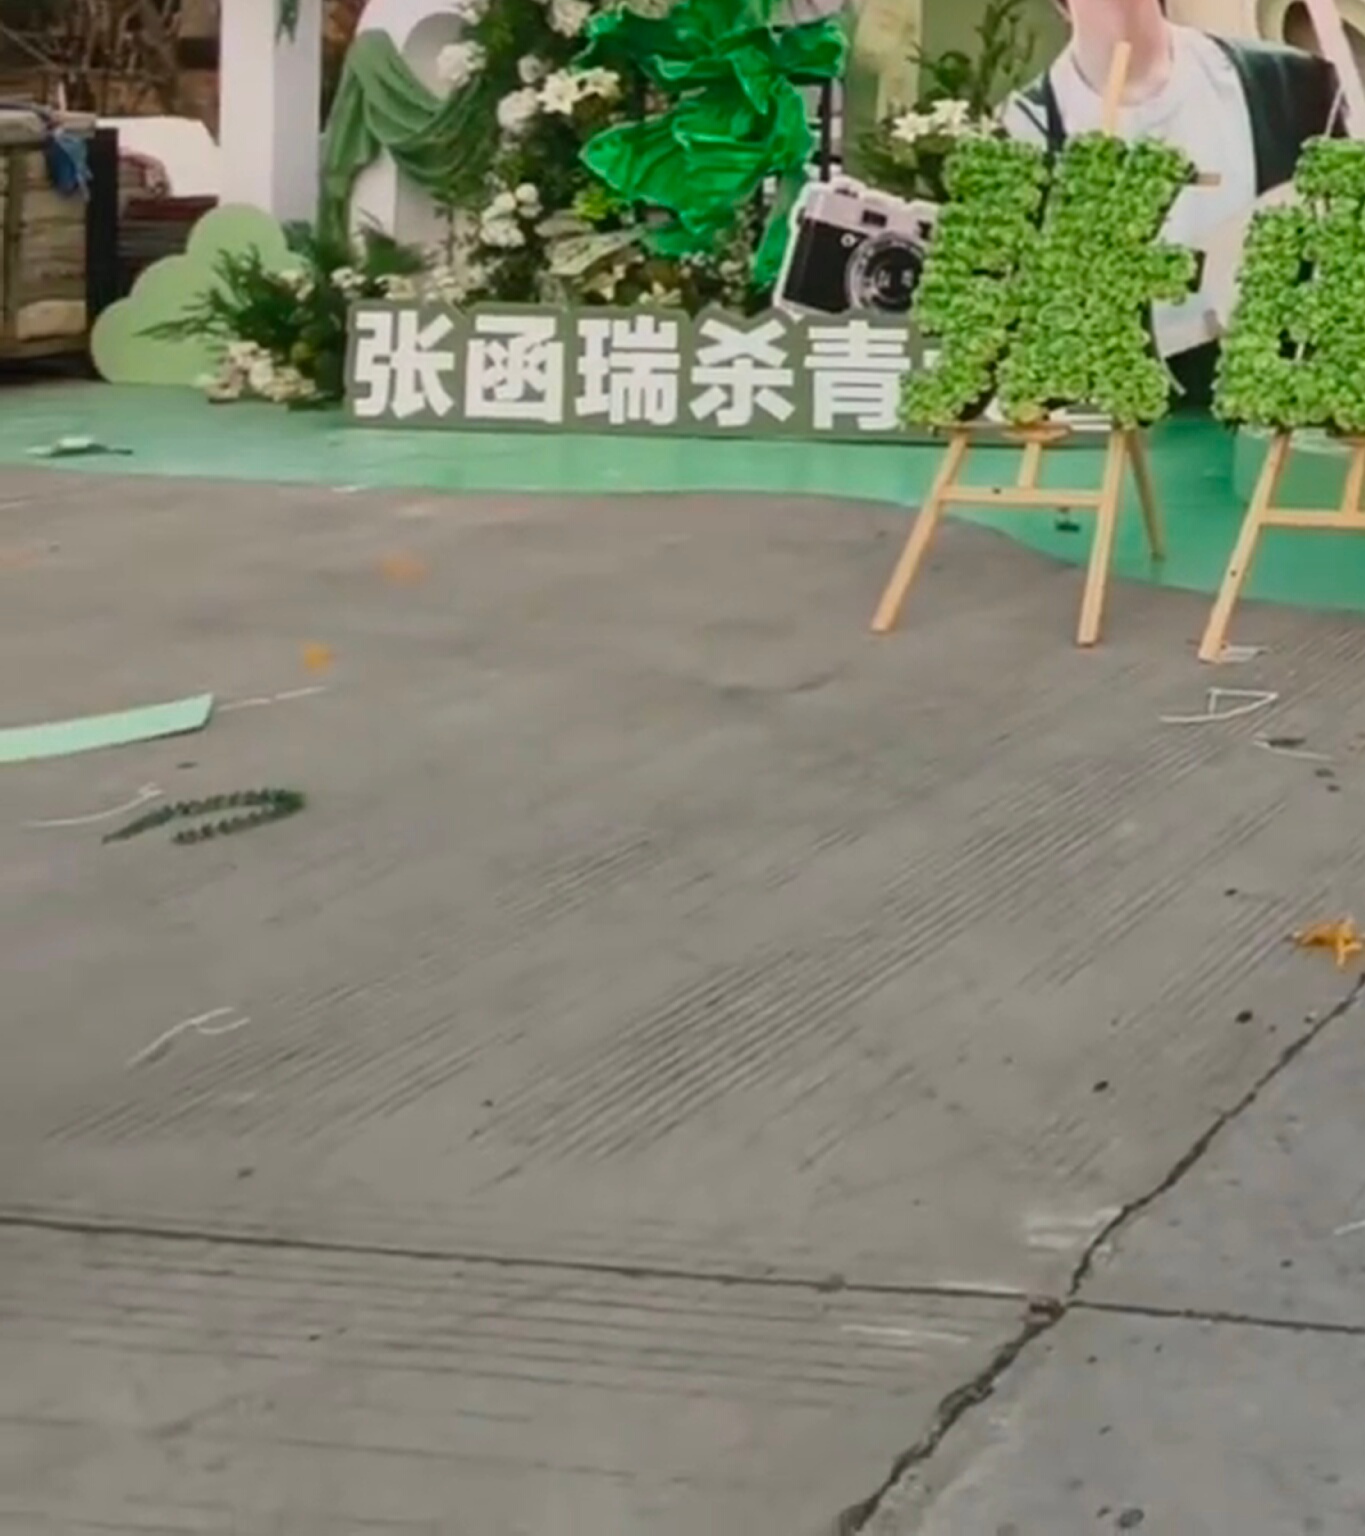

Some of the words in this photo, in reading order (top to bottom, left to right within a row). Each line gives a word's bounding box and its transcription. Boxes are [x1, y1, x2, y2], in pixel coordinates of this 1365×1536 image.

[354, 310, 1112, 432] 张函瑞杀青
